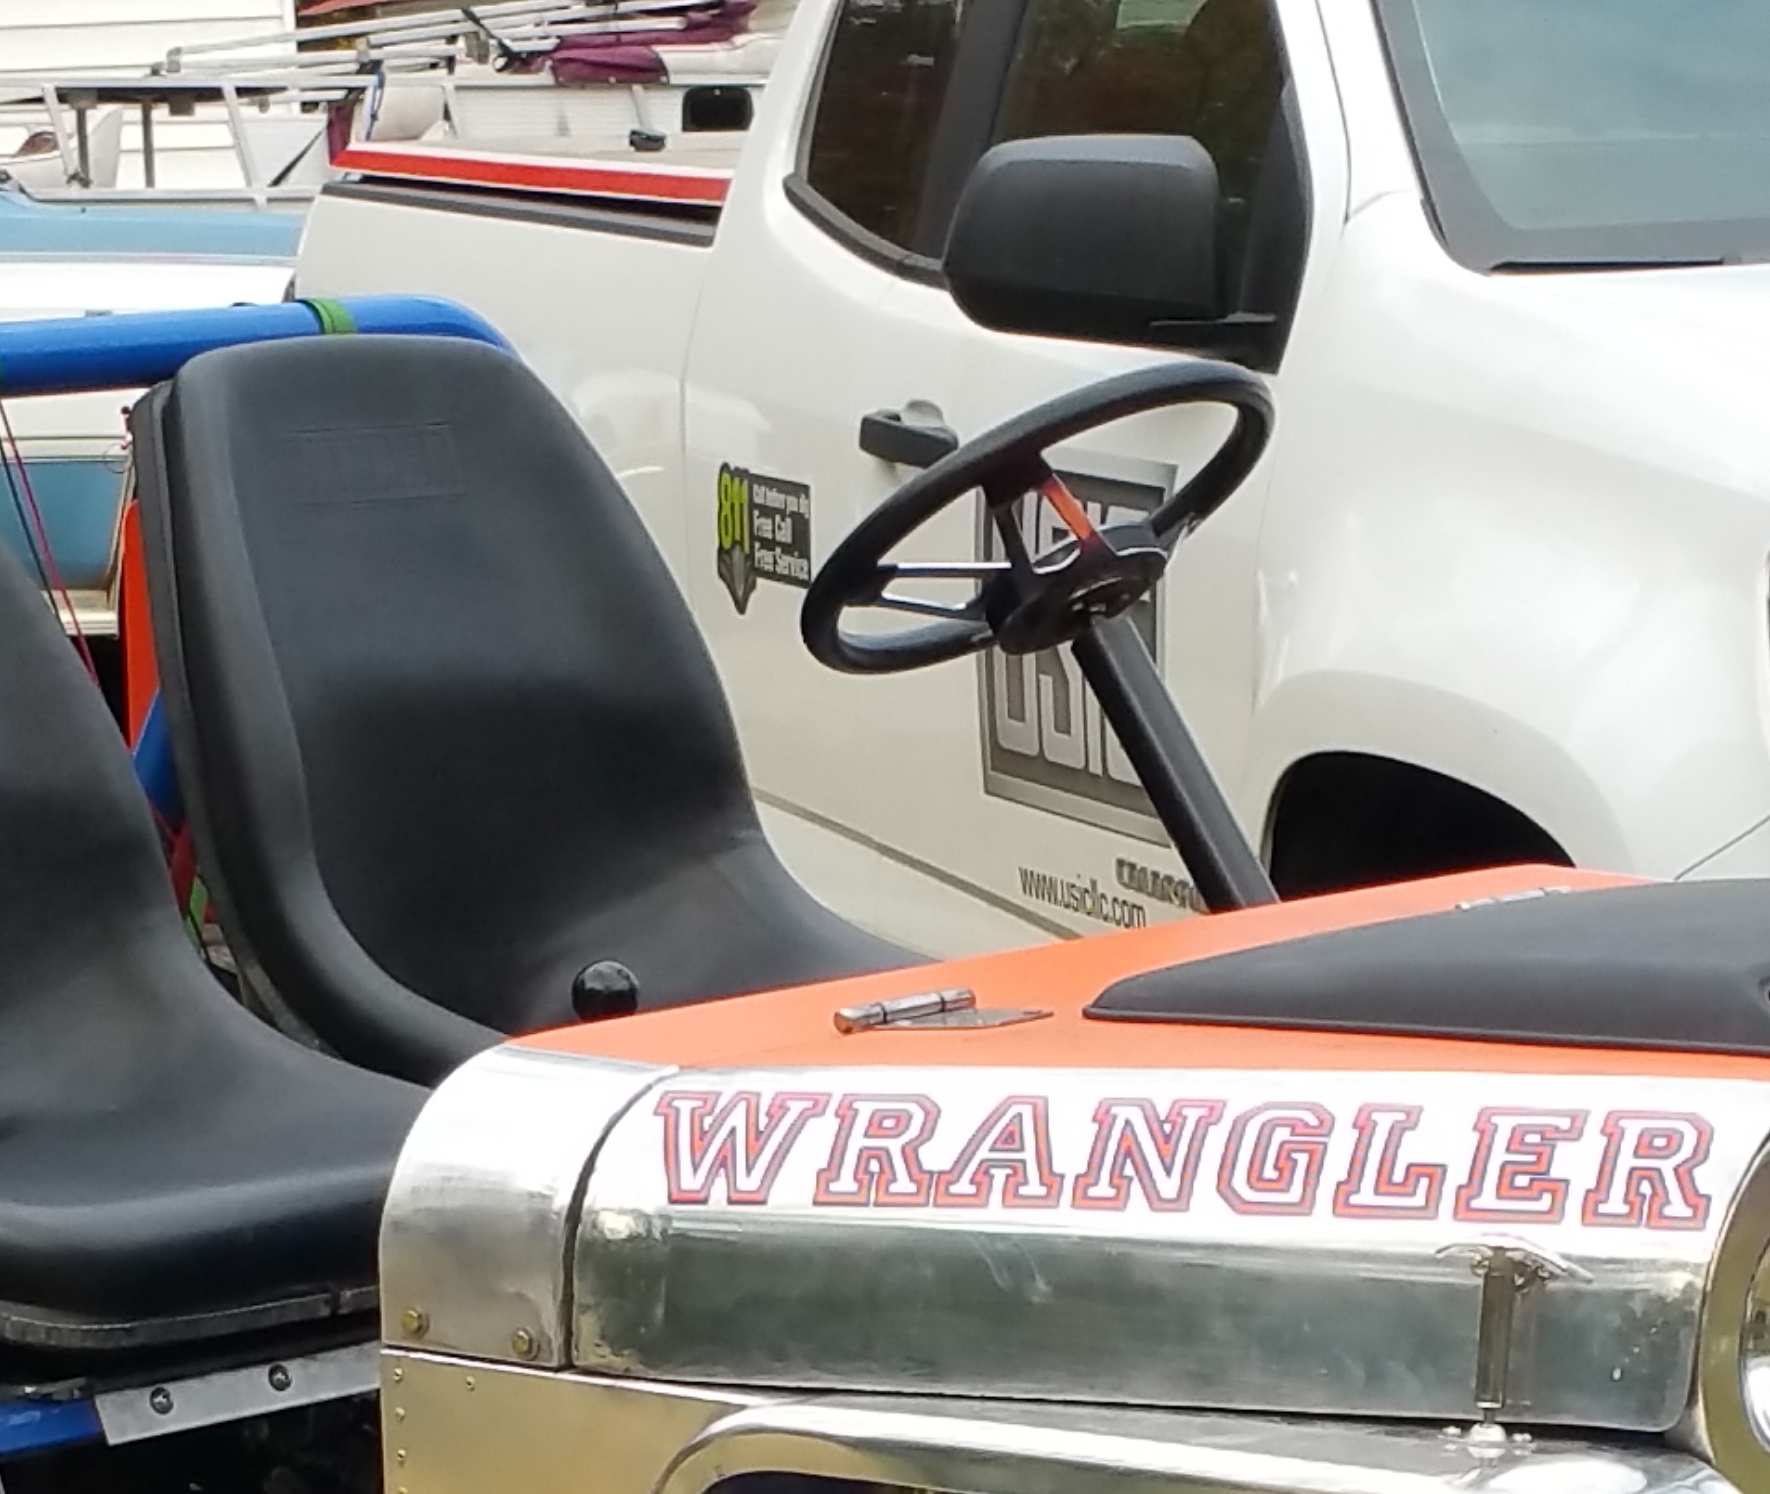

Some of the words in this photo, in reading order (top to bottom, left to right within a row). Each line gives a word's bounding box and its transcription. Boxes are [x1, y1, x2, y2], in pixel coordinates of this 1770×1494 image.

[719, 472, 751, 554] 811
[753, 510, 773, 540] Free
[754, 541, 774, 572] Free
[775, 546, 810, 581] Service
[653, 1088, 1717, 1232] WRANGLER
